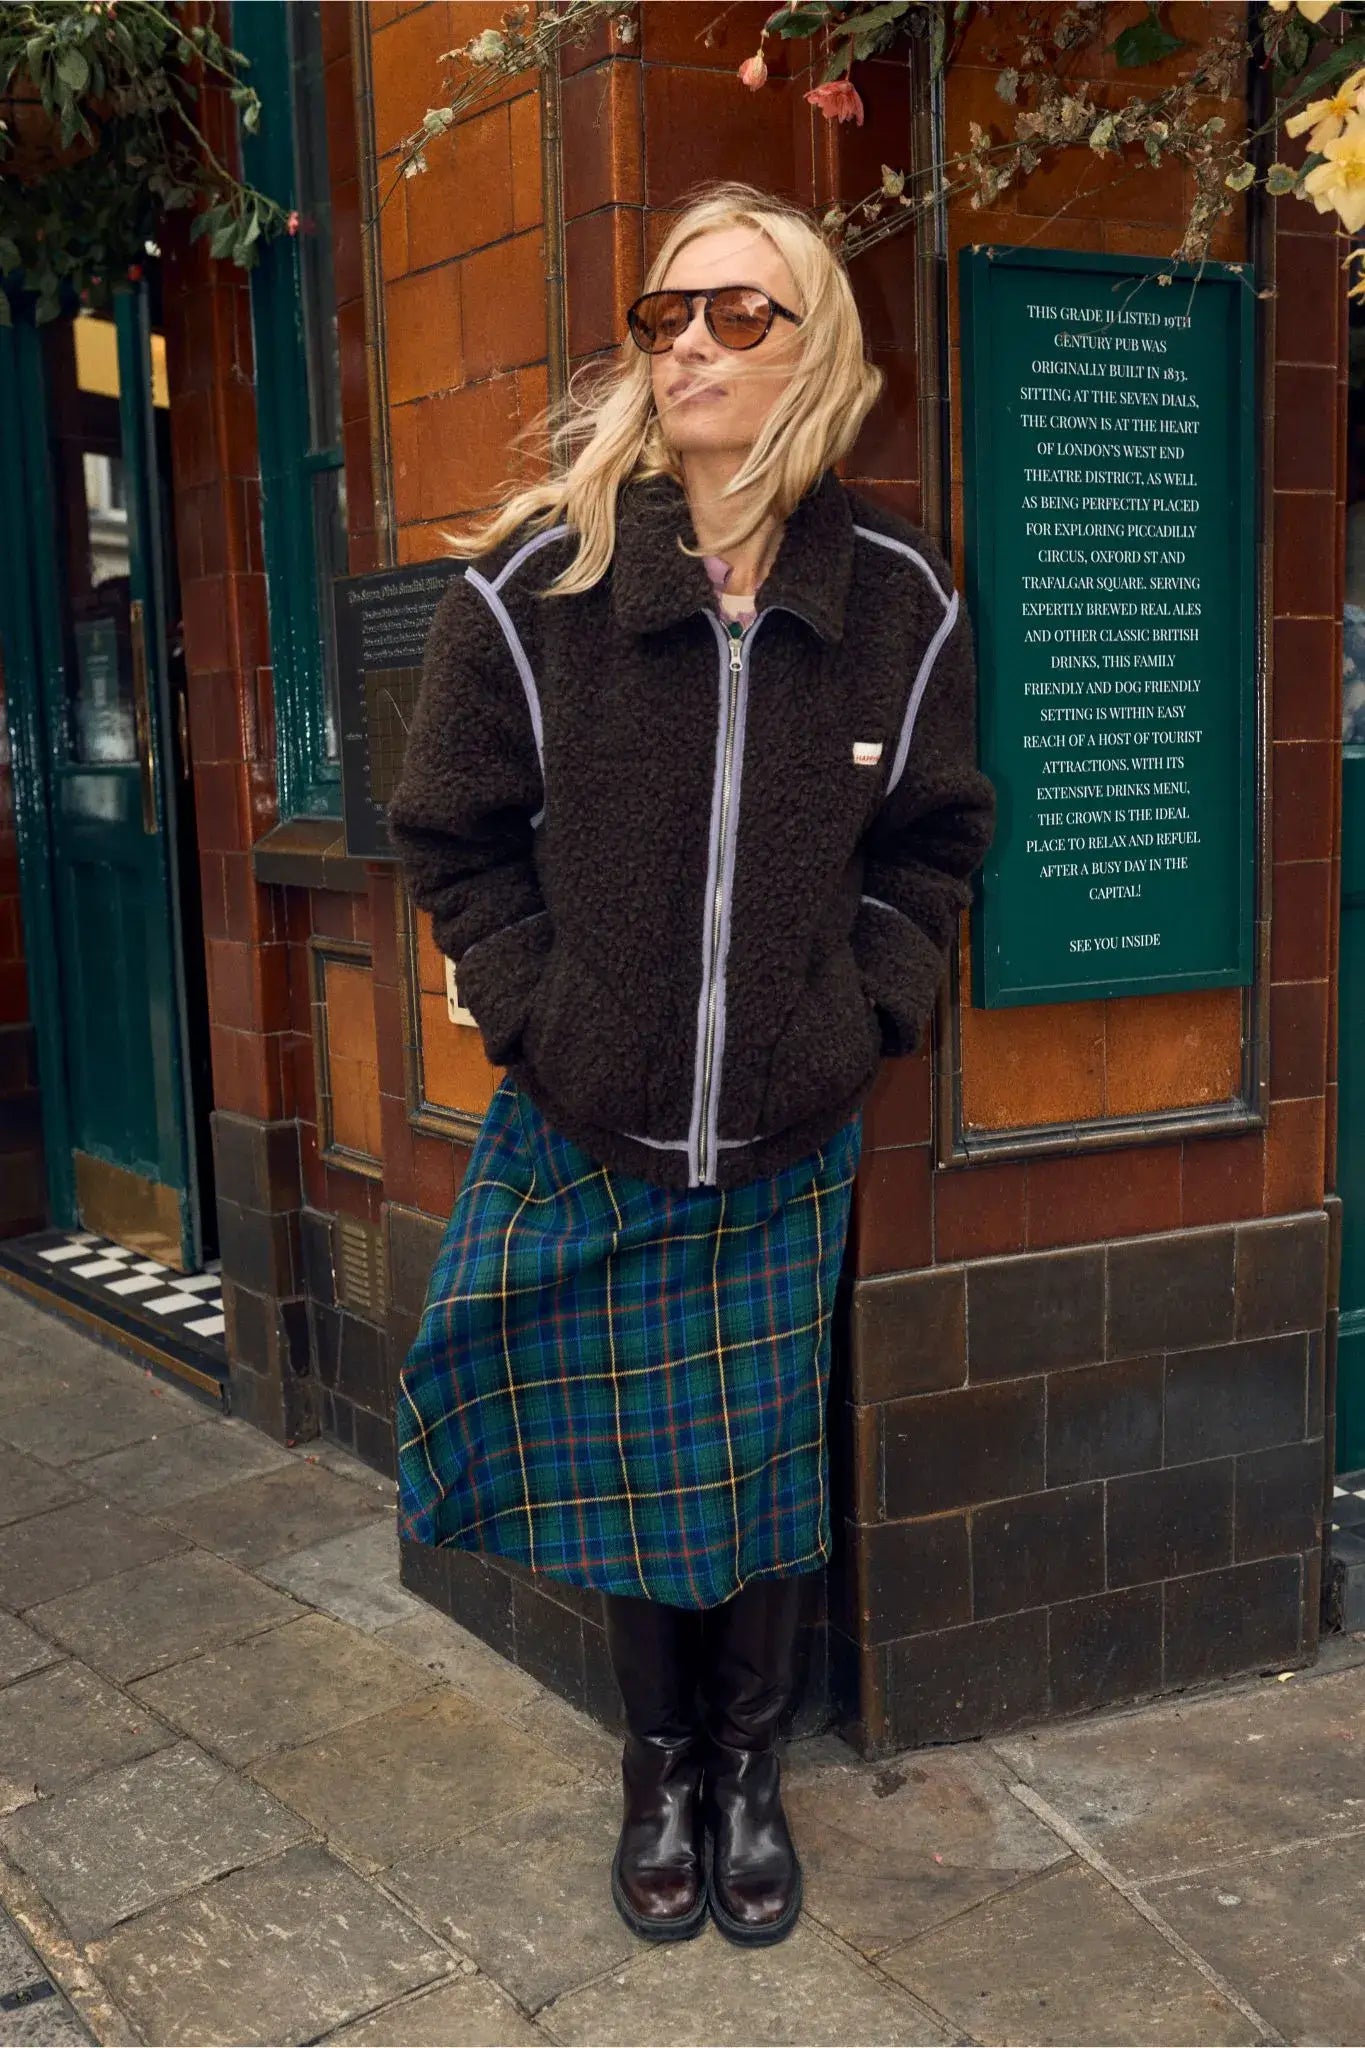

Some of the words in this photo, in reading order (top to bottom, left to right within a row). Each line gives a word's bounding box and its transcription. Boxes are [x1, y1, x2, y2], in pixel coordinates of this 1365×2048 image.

[1027, 305, 1057, 319] THIS
[1060, 308, 1103, 322] GRADE
[1106, 310, 1115, 324] II
[1117, 311, 1160, 325] LISTED
[1164, 316, 1192, 329] 19TH
[1054, 334, 1112, 350] CENTURY
[1116, 338, 1139, 351] PUB
[1141, 339, 1166, 352] WAS
[1032, 361, 1106, 376] ORIGINALLY
[1110, 364, 1144, 378] BUILT
[1148, 366, 1159, 379] IN
[1164, 368, 1187, 382] 1833.
[1021, 387, 1070, 401] SITTING
[1074, 390, 1089, 402] AT
[1092, 390, 1117, 403] THE
[1120, 392, 1158, 405] SEVEN
[1162, 394, 1199, 408] DIALS,
[1021, 414, 1047, 427] THE
[1050, 416, 1097, 429] CROWN
[1101, 418, 1111, 430] IS
[1115, 419, 1129, 431] AT
[1132, 419, 1156, 432] THE
[1160, 420, 1199, 433] HEART
[1038, 442, 1054, 455] OF
[1123, 445, 1157, 458] WEST
[1160, 447, 1184, 459] END
[1024, 469, 1082, 482] THEATRE
[1086, 471, 1144, 485] DISTRICT,
[1147, 473, 1161, 485] AS
[1164, 473, 1197, 486] WELL
[1022, 496, 1037, 508] AS
[1041, 496, 1078, 509] BEING
[1083, 497, 1150, 510] PERFECTLY
[1153, 499, 1199, 512] PLACED
[1027, 523, 1051, 535] FOR
[1055, 523, 1124, 536] EXPLORING
[1128, 525, 1196, 537] PICCADILLY
[1039, 550, 1087, 564] CIRCUS,
[1091, 551, 1141, 563] OXFORD
[1144, 551, 1158, 563] ST
[1160, 552, 1185, 563] AND
[1022, 577, 1093, 589] TRAFALGAR
[1097, 577, 1146, 592] SQUARE.
[1150, 577, 1200, 589] SERVING
[1023, 603, 1083, 615] EXPERTLY
[1087, 603, 1137, 615] BREWED
[1141, 603, 1170, 615] REAL
[1173, 603, 1201, 615] ALES
[1025, 630, 1051, 642] AND
[1054, 630, 1097, 642] OTHER
[1100, 629, 1149, 641] CLASSIC
[1153, 629, 1198, 641] BRITISH
[1052, 656, 1099, 669] DRINKS,
[1102, 656, 1130, 667] THIS
[1134, 655, 1175, 667] FAMILY
[1025, 682, 1084, 695] FRIENDLY
[1086, 682, 1111, 694] AND
[1115, 681, 1141, 693] DOG
[1145, 680, 1200, 692] FRIENDLY
[1041, 708, 1092, 721] SETTING
[1096, 708, 1107, 719] IS
[1109, 707, 1154, 719] WITHIN
[1158, 706, 1186, 718] EASY
[1024, 735, 1065, 748] REACH
[1069, 734, 1085, 746] OF
[1087, 734, 1095, 746] A
[1099, 733, 1131, 745] HOST
[1134, 732, 1150, 744] OF
[1152, 731, 1202, 744] TOURIST
[1132, 757, 1162, 769] WITH
[1167, 757, 1184, 769] ITS
[1037, 785, 1103, 800] EXTENSIVE
[1107, 784, 1150, 796] DRINKS
[1154, 782, 1190, 794] MENU,
[1038, 813, 1063, 825] THE
[1066, 811, 1111, 824] CROWN
[1115, 810, 1125, 822] IS
[1128, 809, 1152, 821] THE
[1156, 807, 1189, 820] IDEAL
[1027, 839, 1065, 852] PLACE
[1068, 838, 1085, 850] TO
[1089, 836, 1126, 849] RELAX
[1129, 834, 1153, 847] AND
[1157, 832, 1200, 845] REFUEL
[1040, 864, 1078, 877] AFTER
[1081, 864, 1089, 875] A
[1092, 861, 1121, 874] BUSY
[1125, 859, 1146, 872] DAY
[1150, 859, 1161, 871] IN
[1164, 857, 1188, 869] THE
[1090, 884, 1140, 900] CAPITAL!
[1070, 939, 1091, 952] SEE
[1094, 937, 1118, 950] YOU
[1122, 934, 1160, 948] INSIDE
